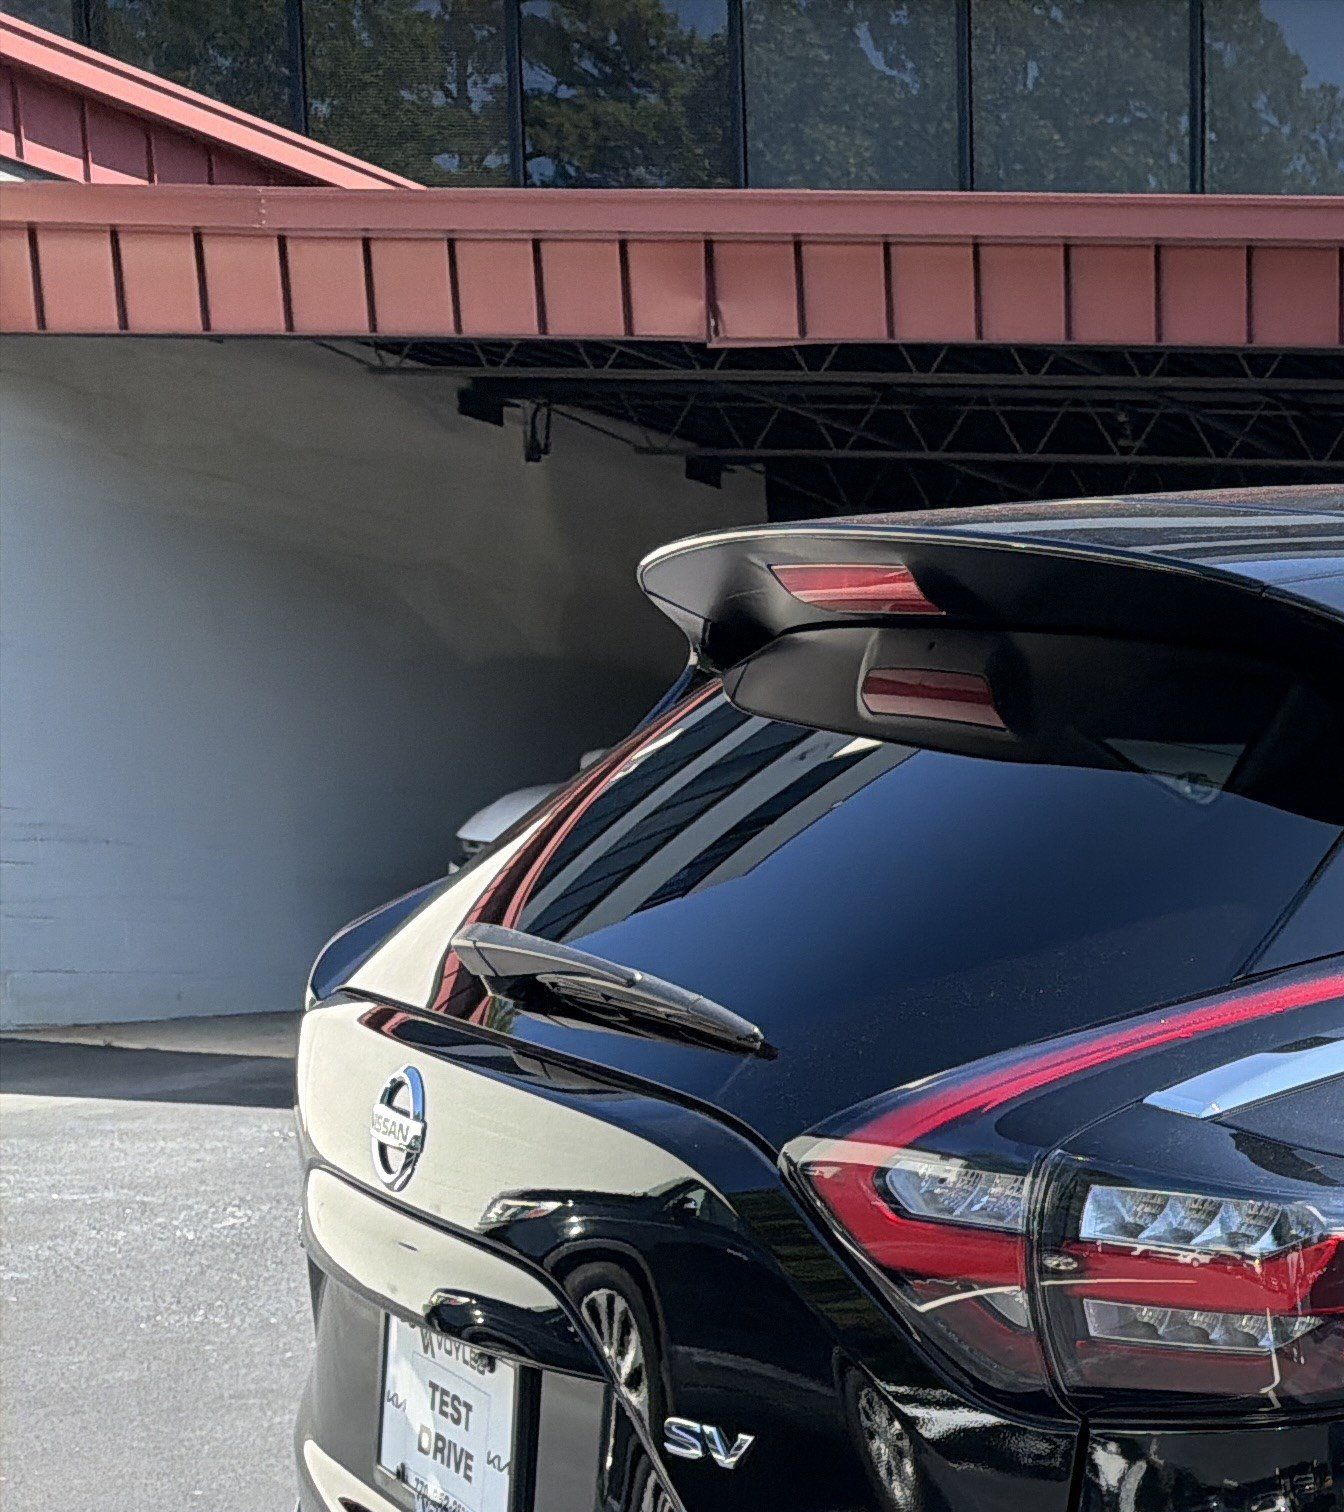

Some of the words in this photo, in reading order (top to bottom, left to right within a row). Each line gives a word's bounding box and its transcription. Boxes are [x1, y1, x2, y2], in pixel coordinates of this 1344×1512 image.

[371, 1113, 410, 1142] ISSAN
[429, 1380, 473, 1431] TEST
[418, 1424, 475, 1484] DRIVE
[664, 1417, 755, 1469] SV
